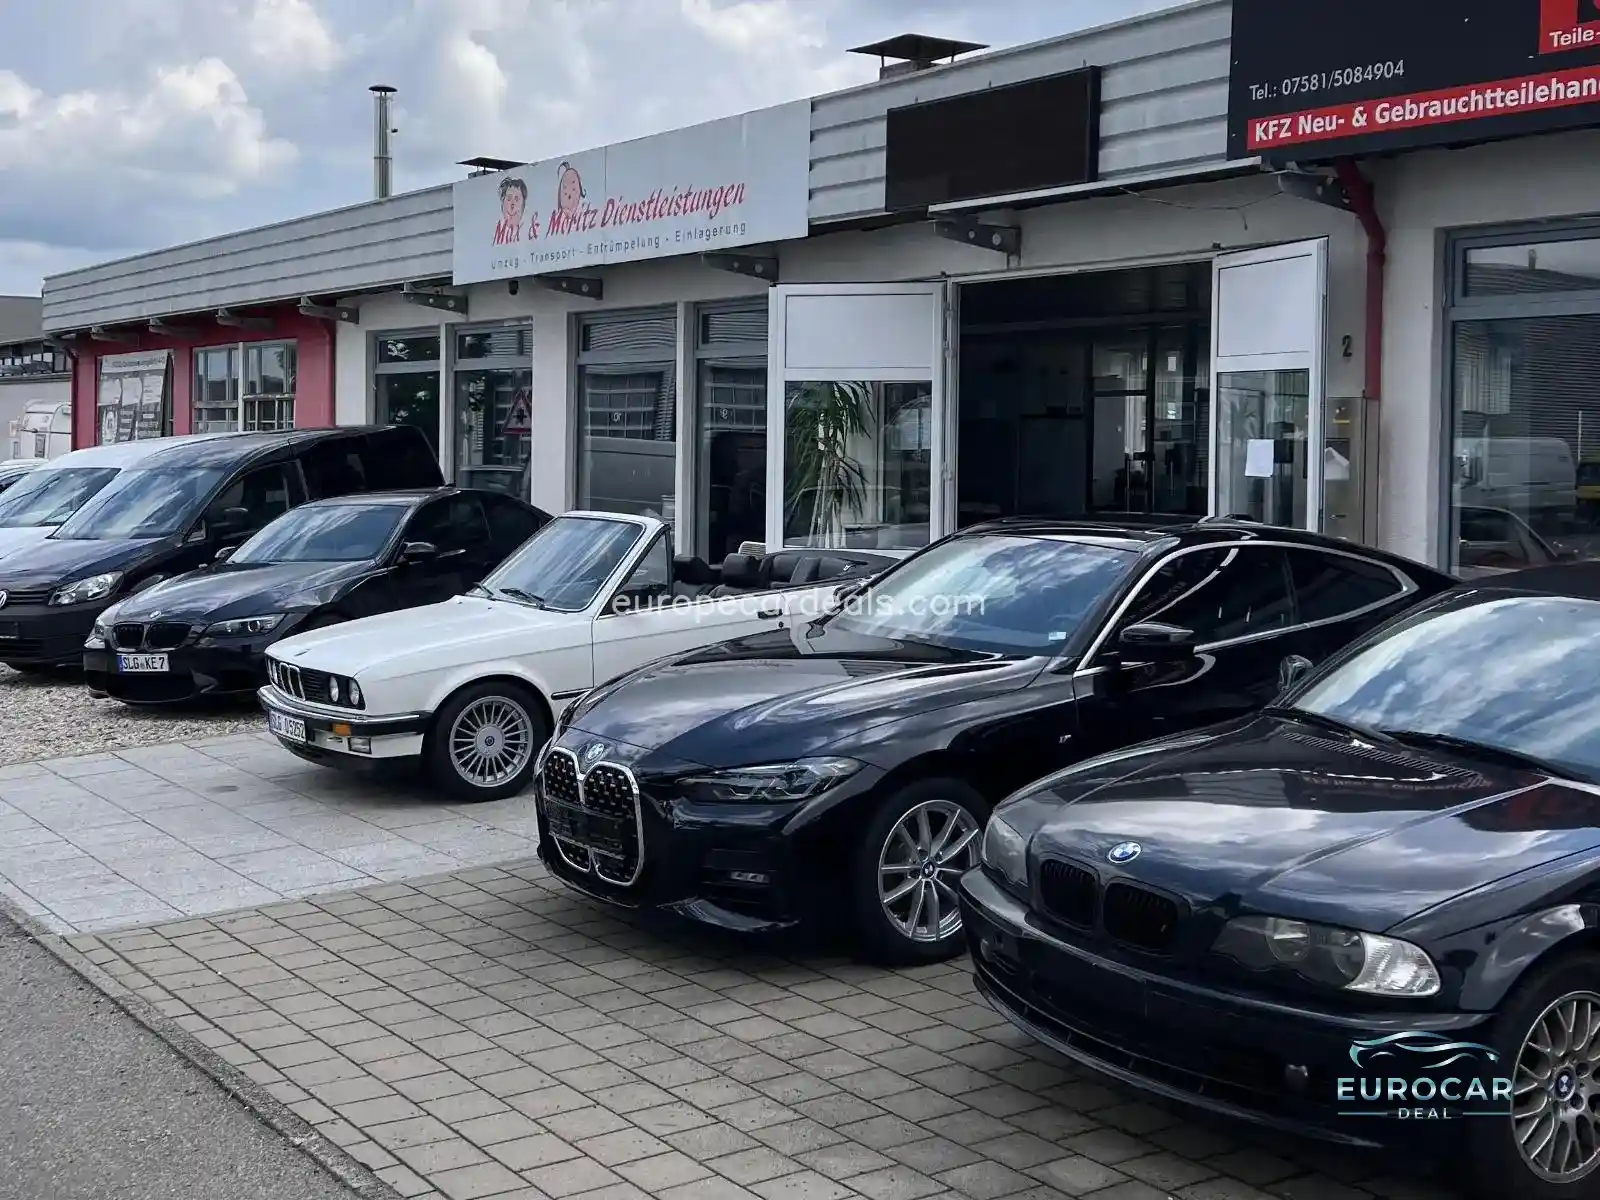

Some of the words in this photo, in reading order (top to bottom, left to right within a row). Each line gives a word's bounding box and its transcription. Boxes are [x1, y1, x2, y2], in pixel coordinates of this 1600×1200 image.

[1249, 83, 1277, 100] Tel.:
[1282, 59, 1404, 95] 07581/5084904
[1255, 118, 1292, 142] KFZ
[1298, 114, 1345, 135] Neu-
[1351, 106, 1368, 127] &
[1375, 77, 1600, 124] Gebrauchtteilehan
[492, 218, 524, 246] Max
[528, 211, 540, 240] &
[544, 201, 599, 240] Moritz
[601, 182, 745, 227] Dienstleistungen
[530, 249, 575, 262] Transport
[587, 236, 660, 254] Entrümpelung
[675, 222, 746, 242] Einlagerung
[1342, 334, 1353, 358] 2
